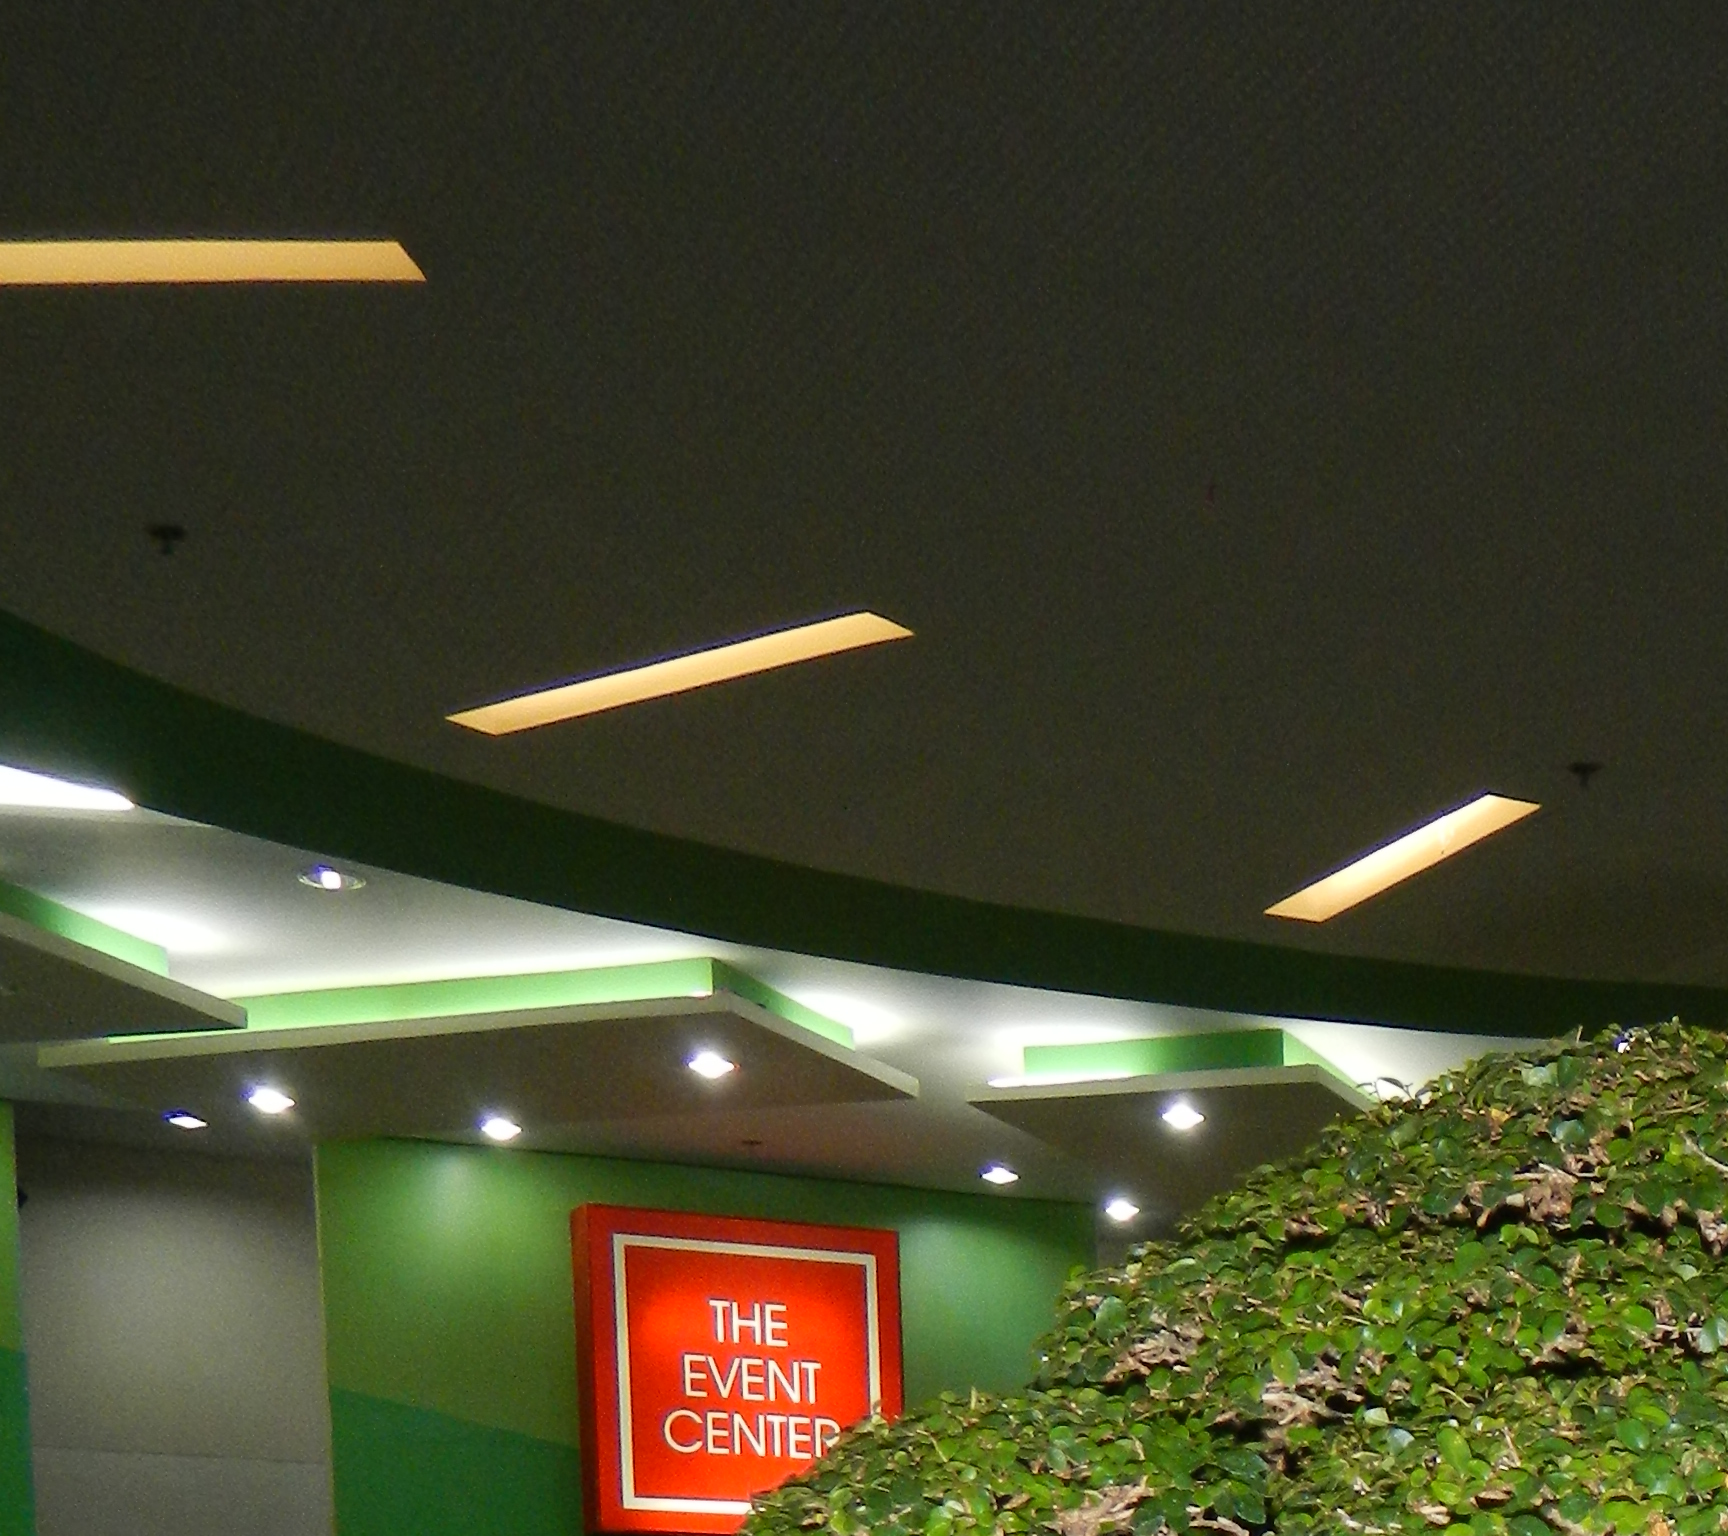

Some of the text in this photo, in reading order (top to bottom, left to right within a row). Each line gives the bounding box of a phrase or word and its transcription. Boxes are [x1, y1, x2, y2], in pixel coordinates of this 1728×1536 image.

[708, 1299, 789, 1347] THE
[683, 1354, 821, 1404] EVENT
[663, 1409, 842, 1460] CENTER
